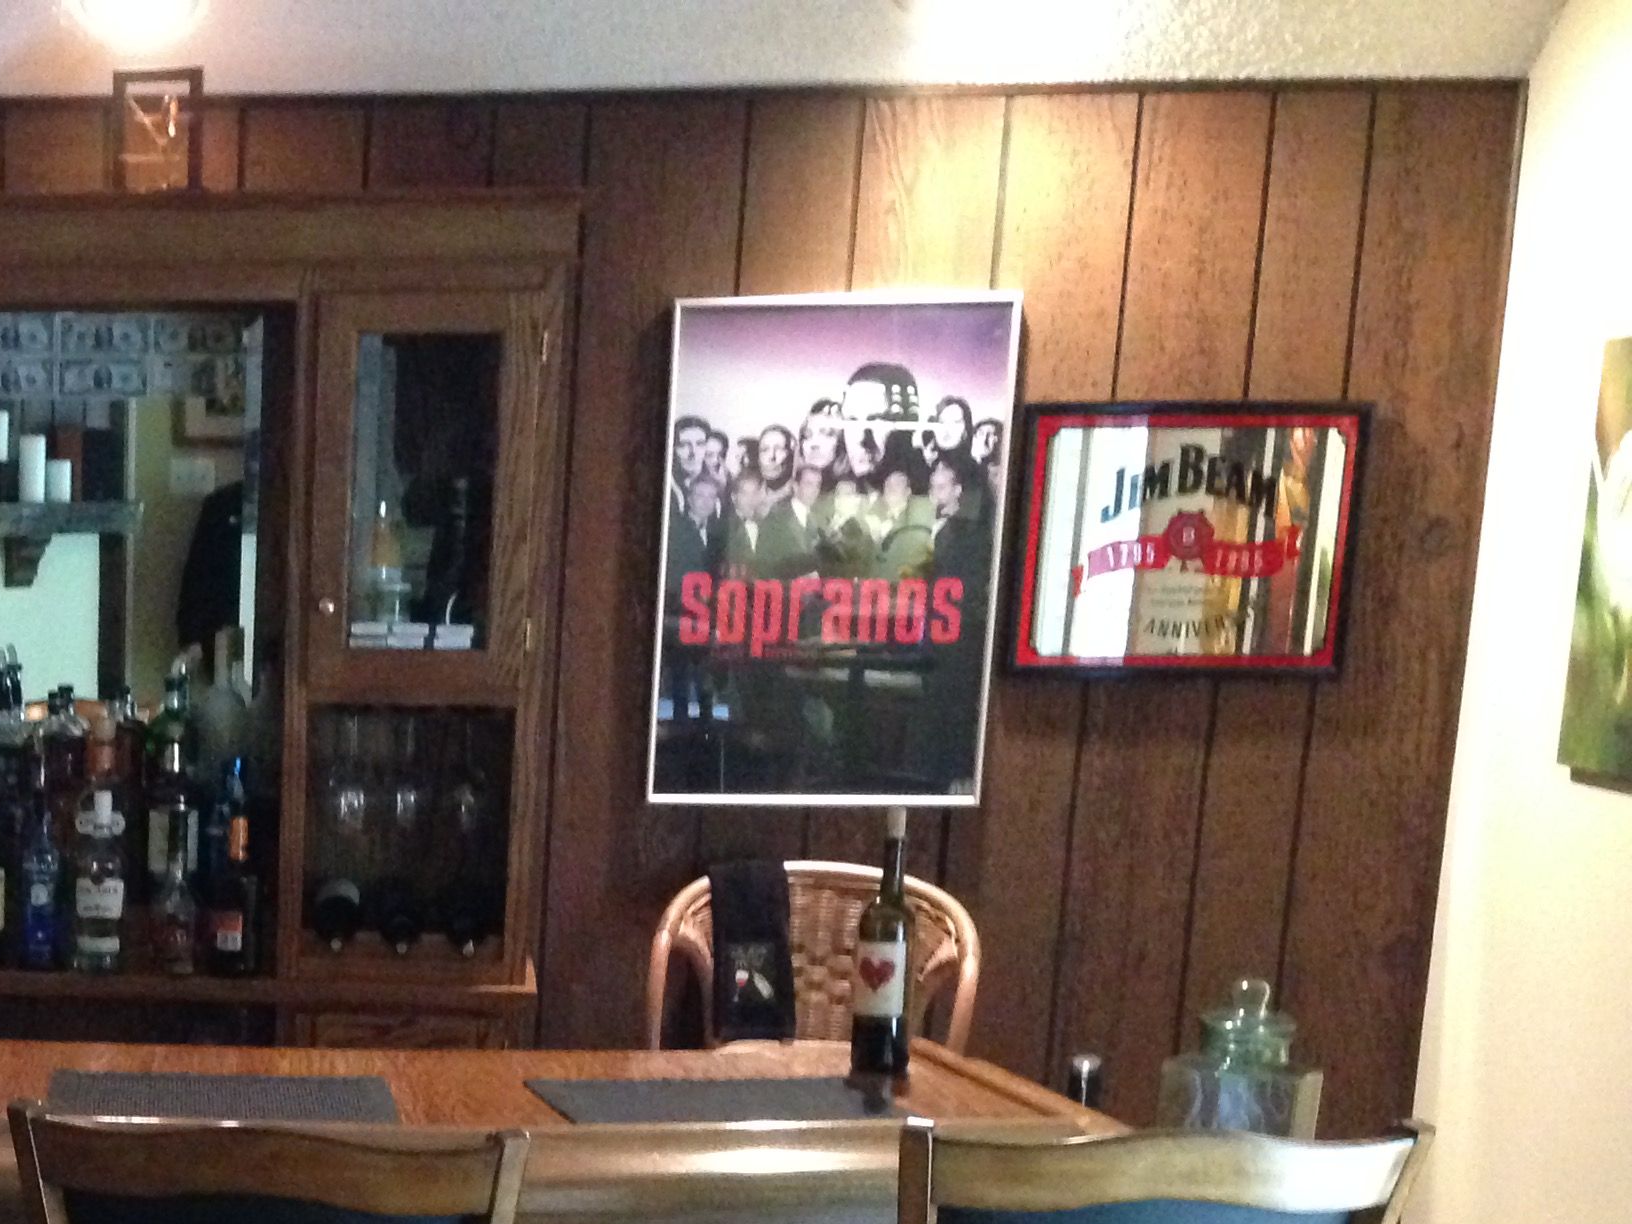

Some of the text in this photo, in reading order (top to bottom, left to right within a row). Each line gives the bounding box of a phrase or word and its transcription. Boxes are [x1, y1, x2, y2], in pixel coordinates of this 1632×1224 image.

[1101, 444, 1277, 522] JIM BEAM
[679, 571, 964, 658] Sopranos
